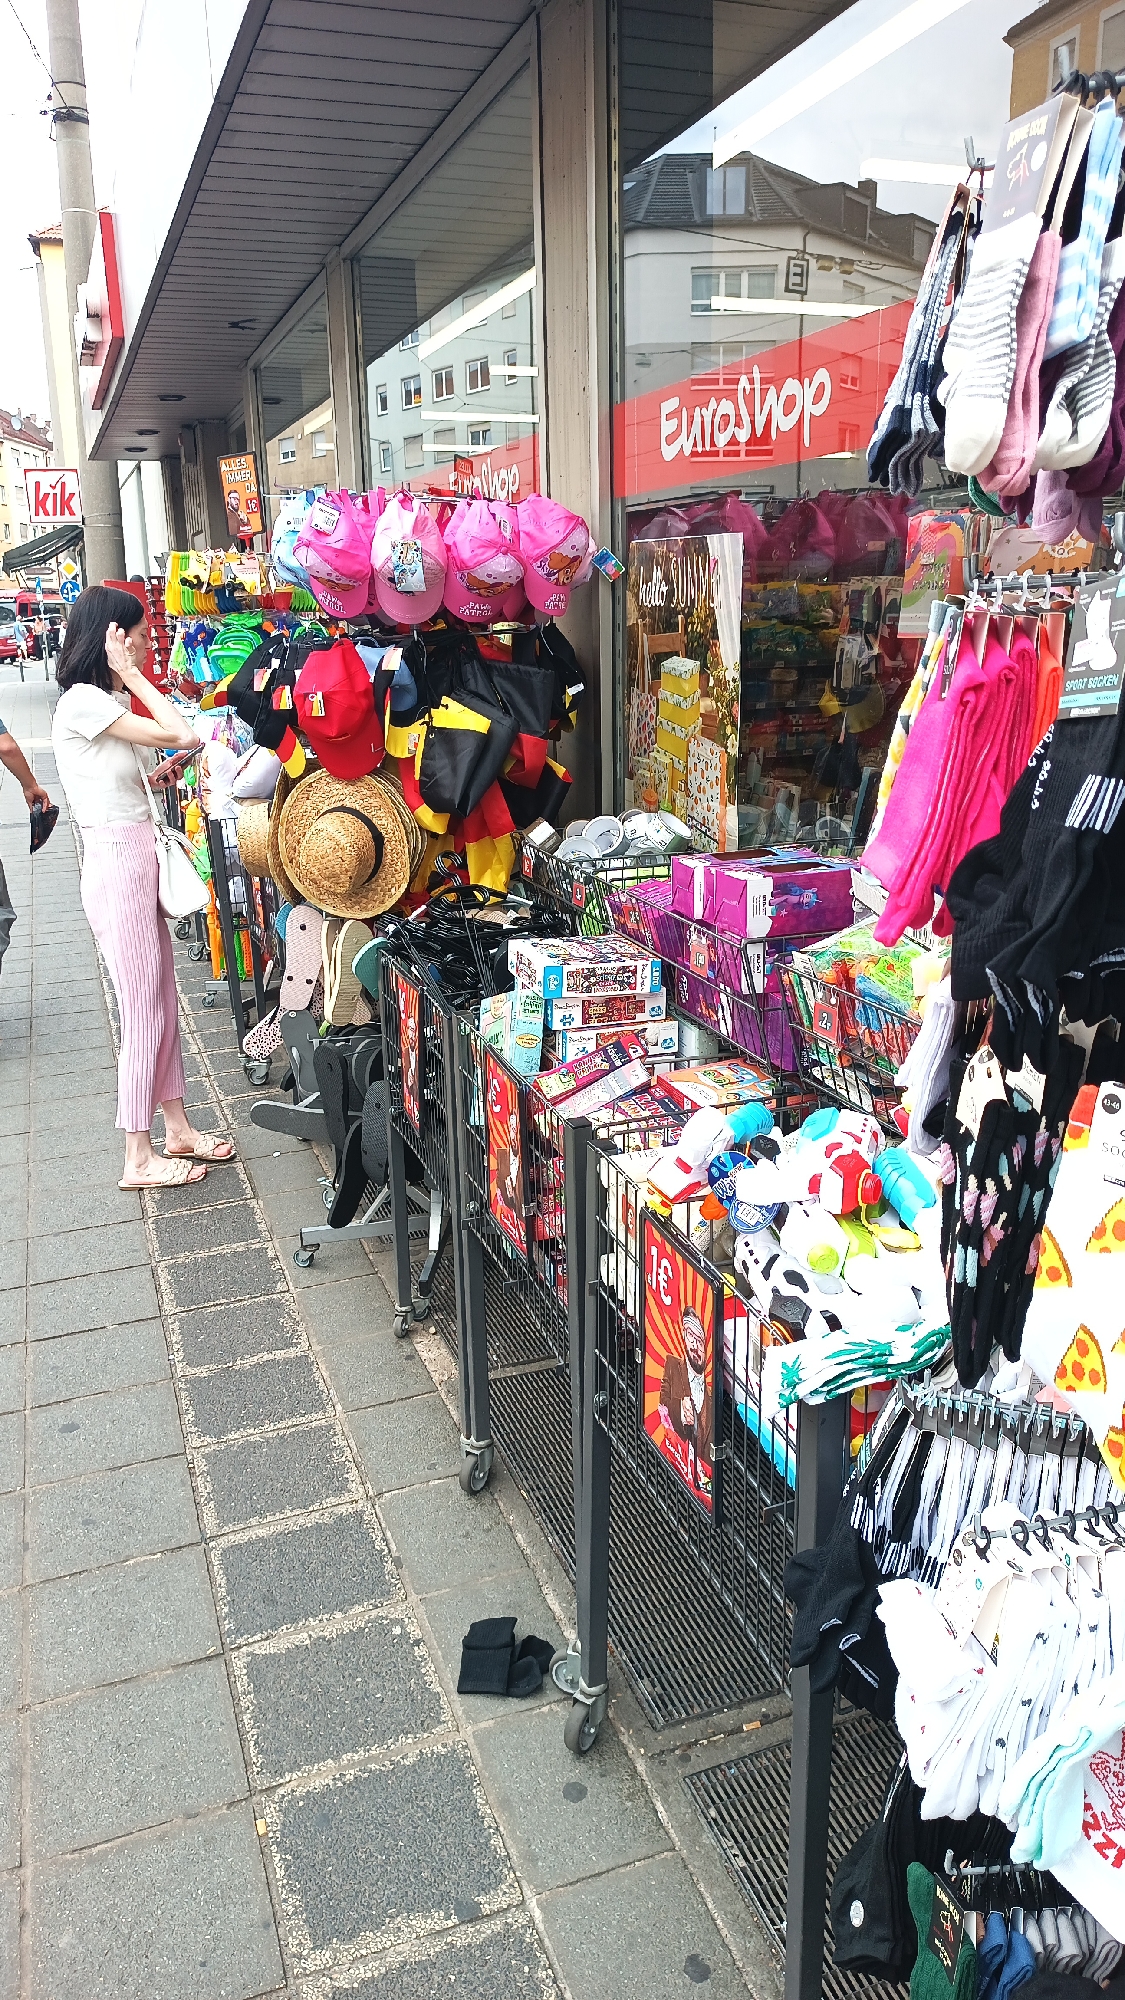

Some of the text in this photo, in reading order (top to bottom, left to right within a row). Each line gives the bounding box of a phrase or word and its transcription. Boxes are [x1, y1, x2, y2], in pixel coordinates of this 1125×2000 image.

[660, 365, 832, 462] EuroShop
[639, 566, 668, 608] hello
[1087, 673, 1119, 690] SOCKEN
